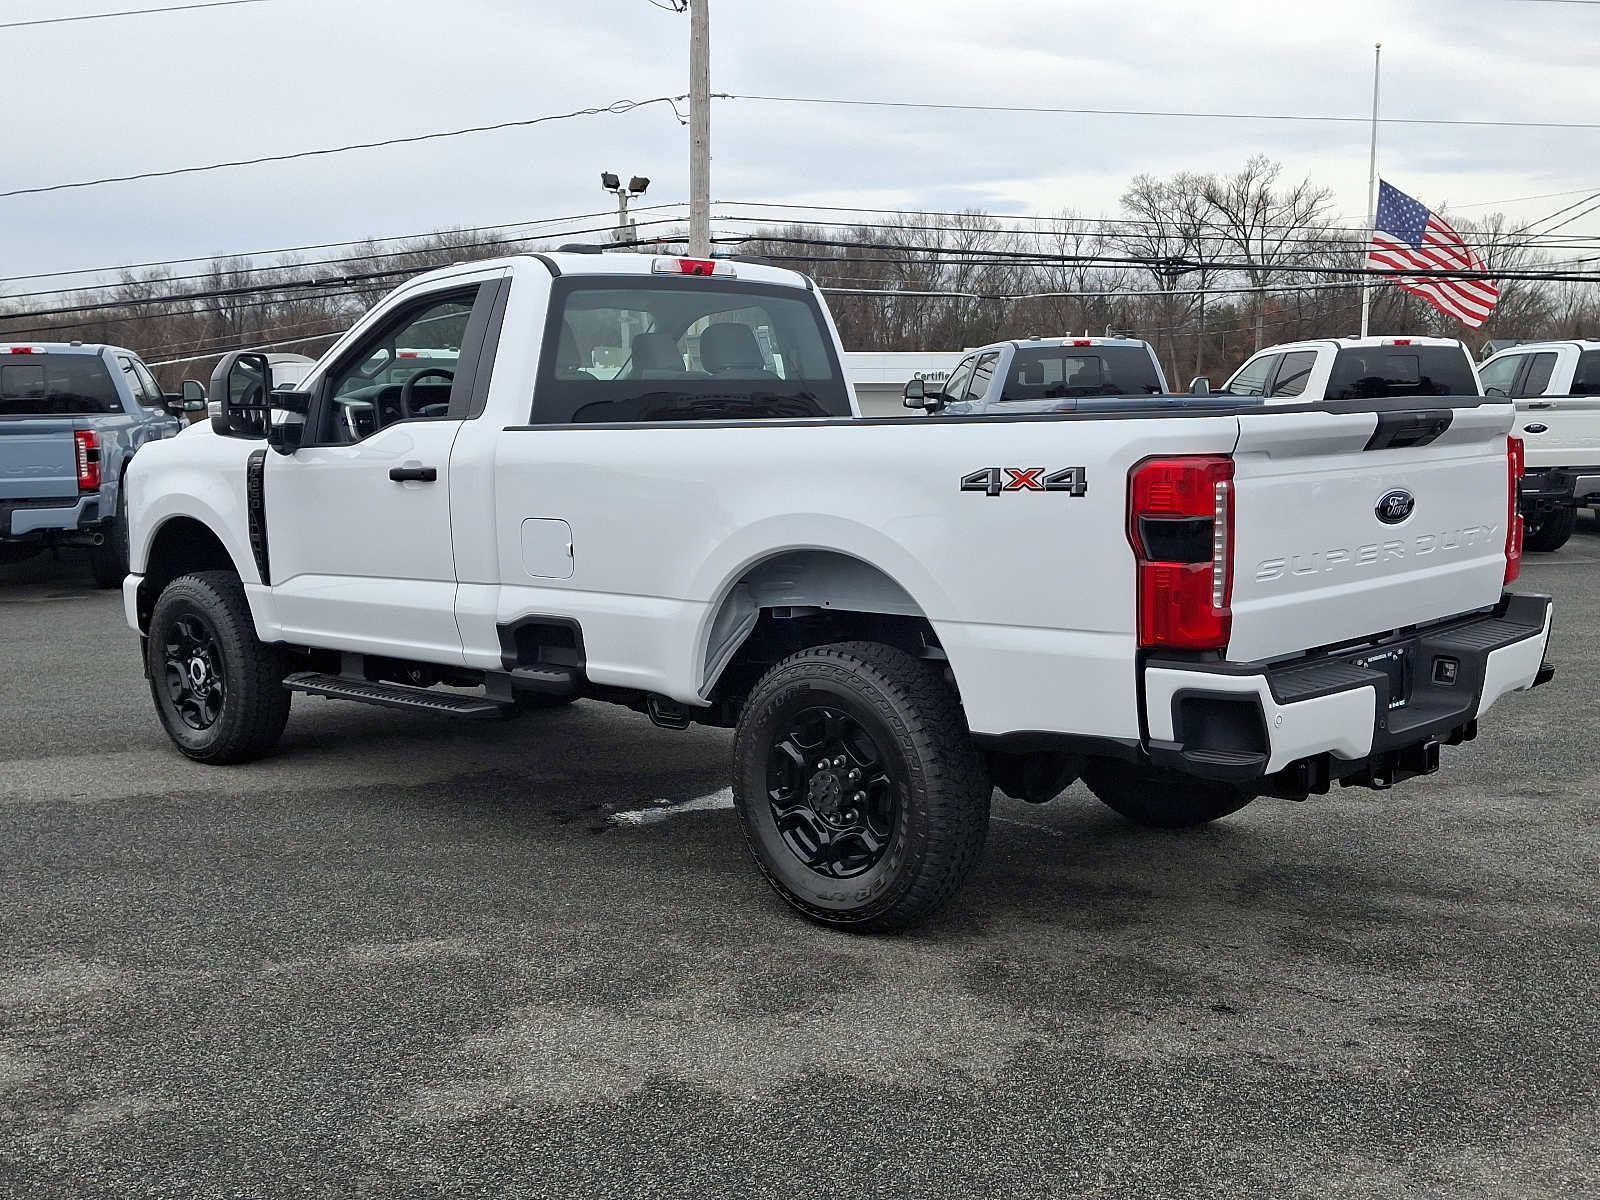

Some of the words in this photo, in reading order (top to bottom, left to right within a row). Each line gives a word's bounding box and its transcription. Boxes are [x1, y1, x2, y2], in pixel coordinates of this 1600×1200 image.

[913, 371, 951, 381] Certifie
[1255, 540, 1405, 583] SUPER
[1415, 523, 1499, 556] DUTY
